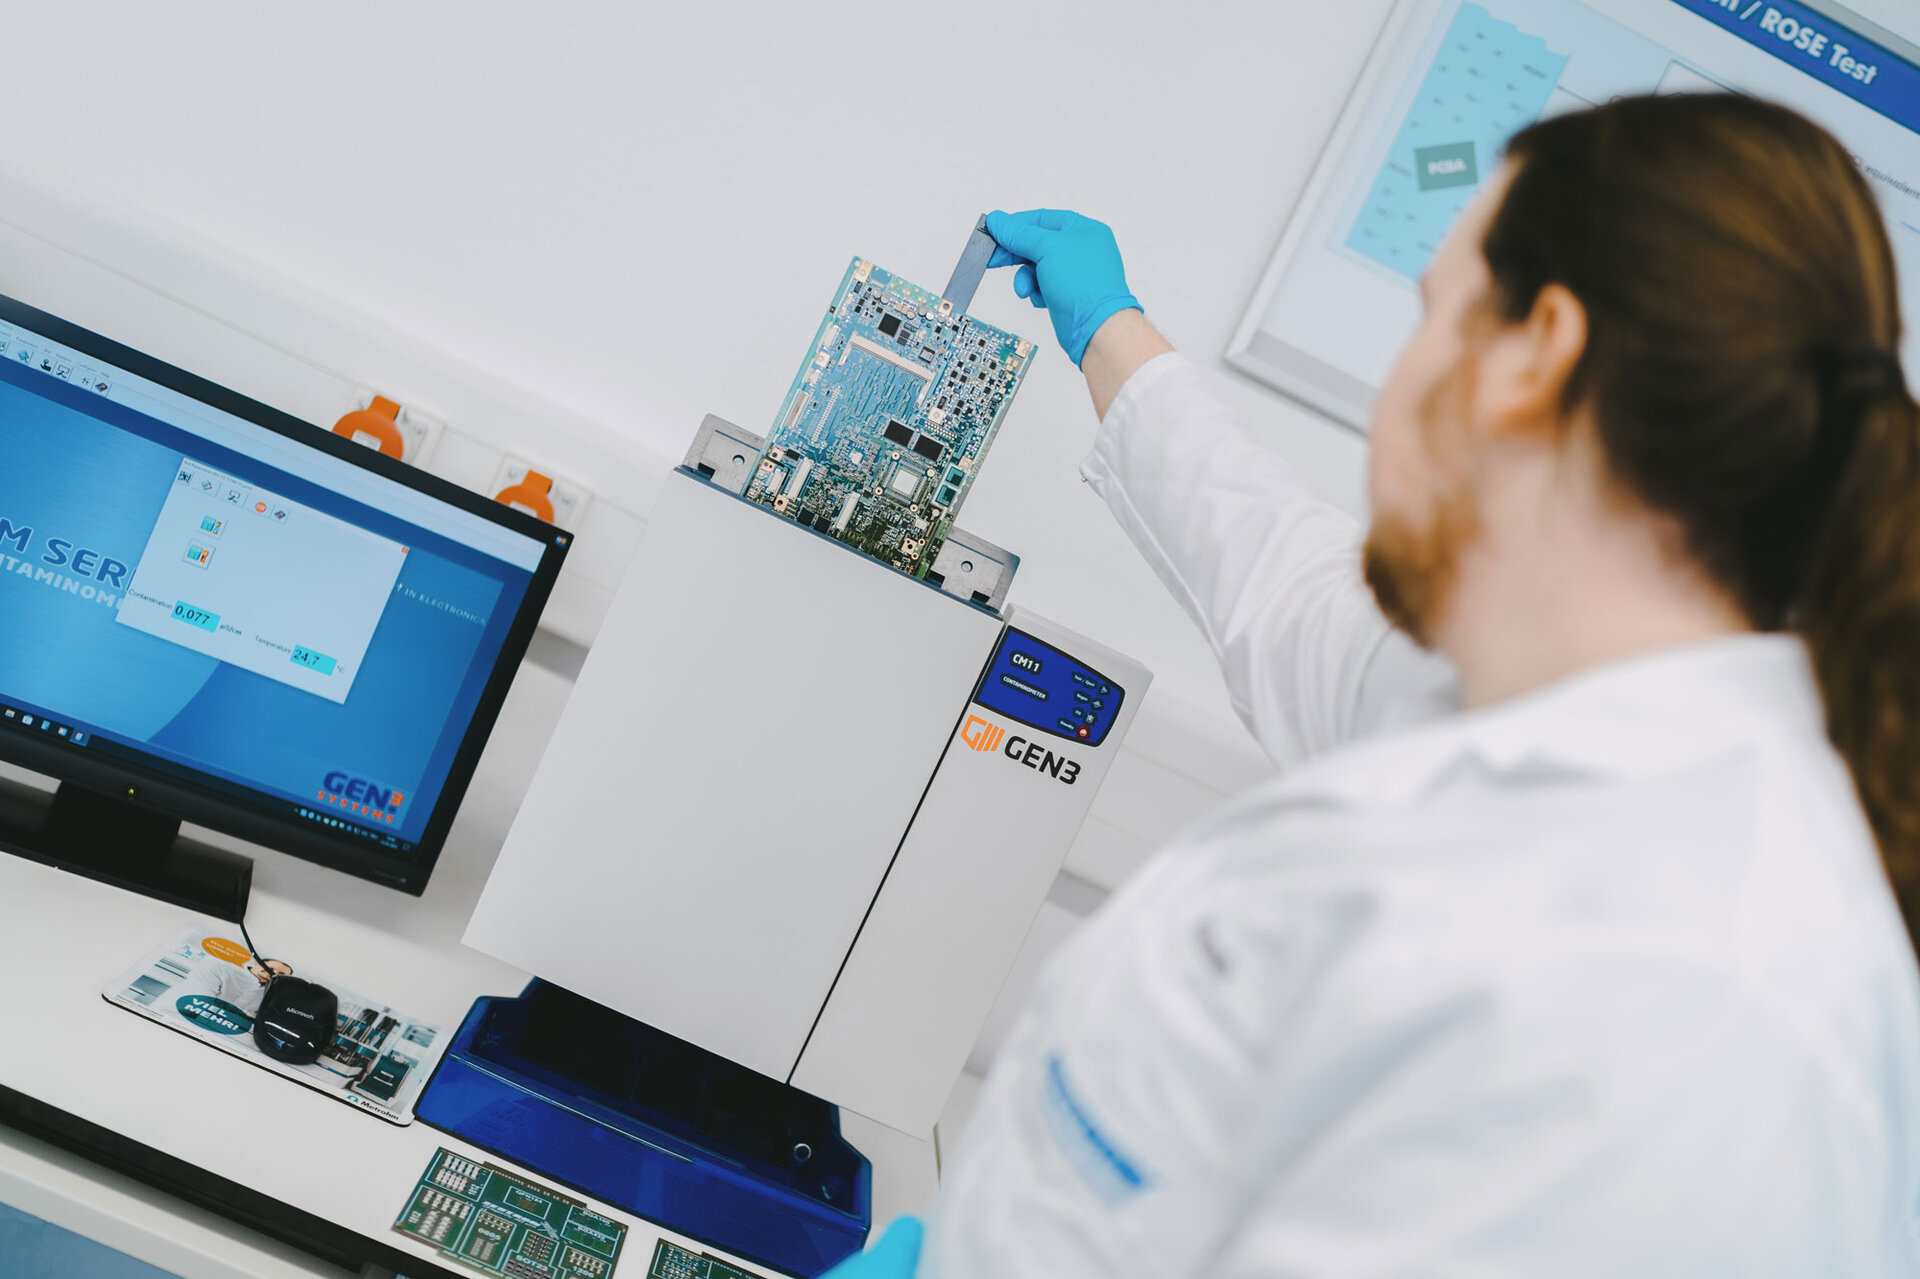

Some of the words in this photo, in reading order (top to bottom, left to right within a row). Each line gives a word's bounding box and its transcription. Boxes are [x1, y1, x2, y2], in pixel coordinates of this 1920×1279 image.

[1760, 8, 1829, 58] ROSE
[1829, 44, 1878, 85] Test
[1427, 158, 1467, 175] PCBA
[41, 537, 137, 591] SER
[418, 593, 488, 627] ELECTRONICS
[1012, 652, 1040, 673] CM11
[1002, 675, 1047, 700] CONTAMINOMETER
[1004, 735, 1082, 785] GEN3
[316, 790, 395, 824] SYSTEMS
[184, 1003, 240, 1031] MEHR!
[192, 997, 228, 1018] VIEL
[286, 1006, 315, 1021] Microsoft
[360, 1100, 399, 1121] Metrohm
